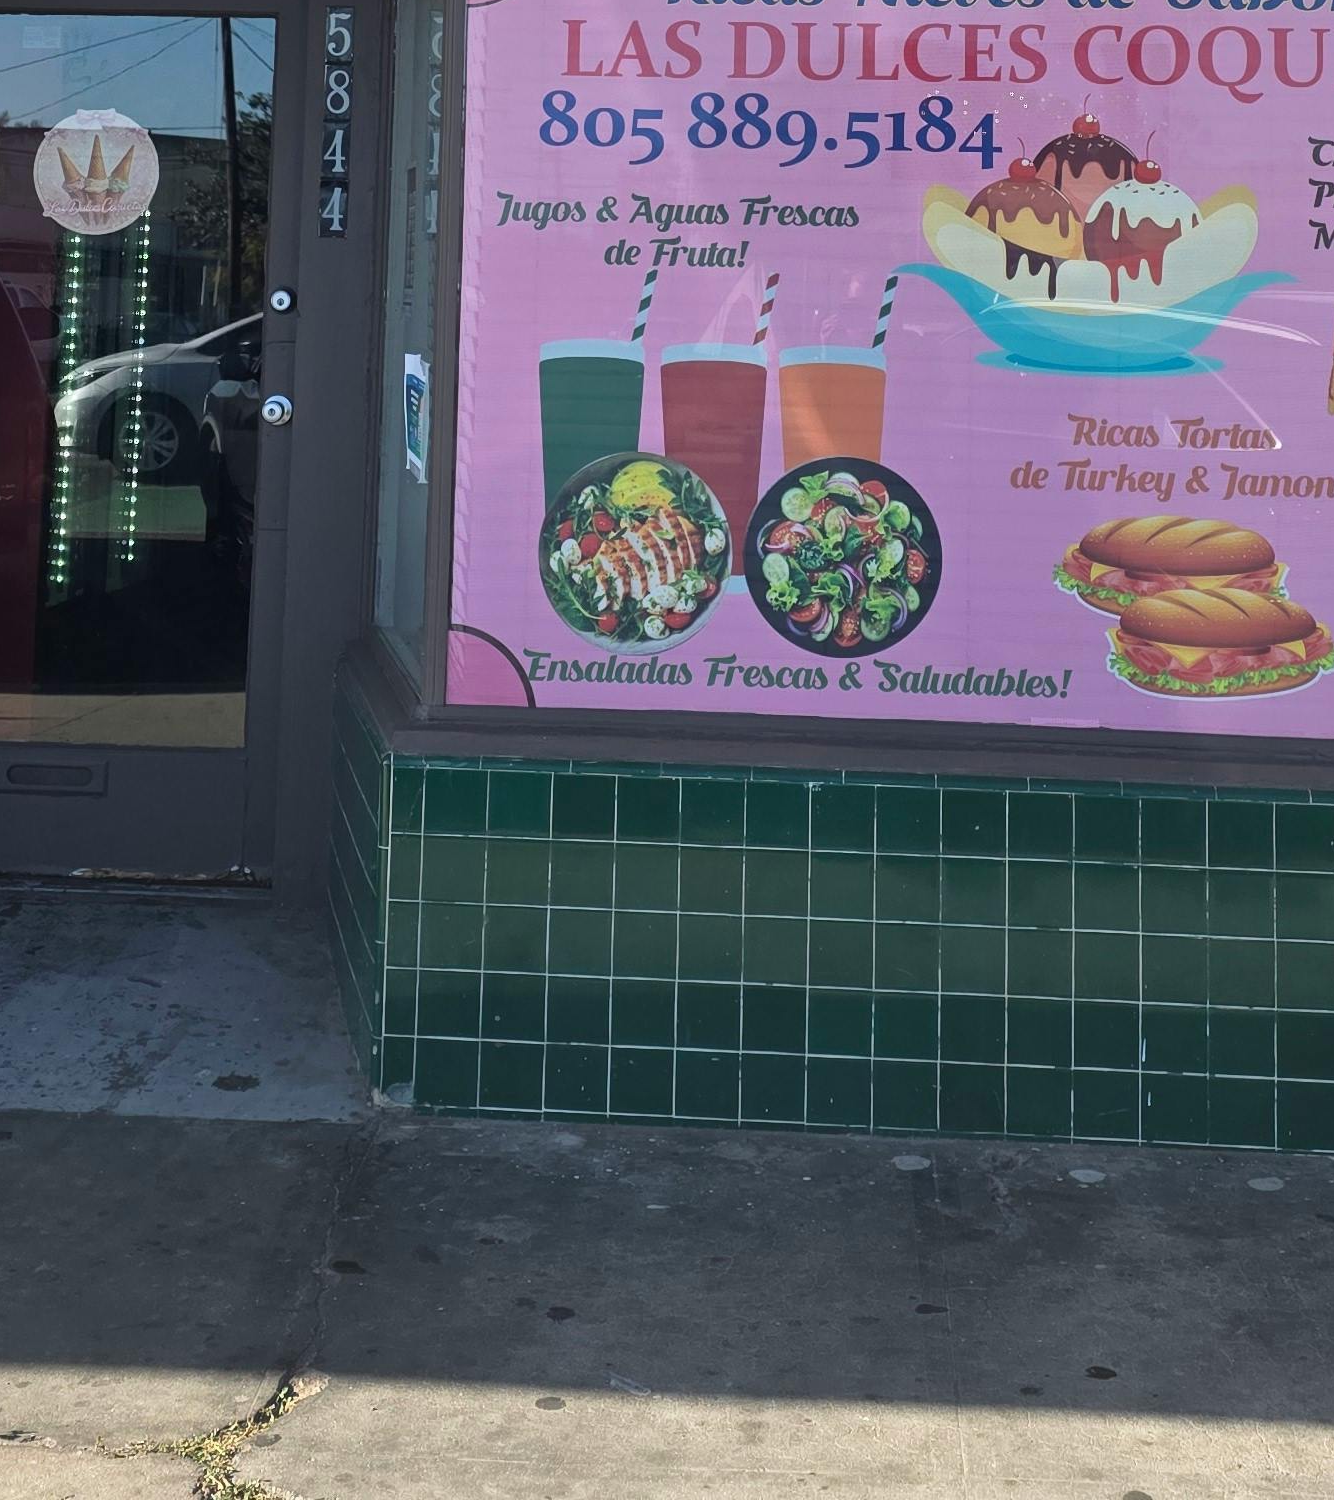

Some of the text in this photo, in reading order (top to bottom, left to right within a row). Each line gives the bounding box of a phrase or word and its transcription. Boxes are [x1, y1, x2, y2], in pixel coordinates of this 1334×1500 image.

[560, 19, 702, 79] LAS
[727, 21, 1048, 84] DULCES
[321, 13, 352, 231] 5844
[539, 89, 1003, 170] 805 889.5184
[496, 190, 860, 233] Jugos & Aguas Frescas
[603, 235, 750, 268] de Fruta!
[1067, 412, 1276, 450] Ricas Tortas
[1010, 460, 1049, 490] de
[1057, 457, 1176, 503] Turkey
[1185, 465, 1210, 495] &
[521, 646, 1074, 699] Ensaladas Frescas & Saludables!
